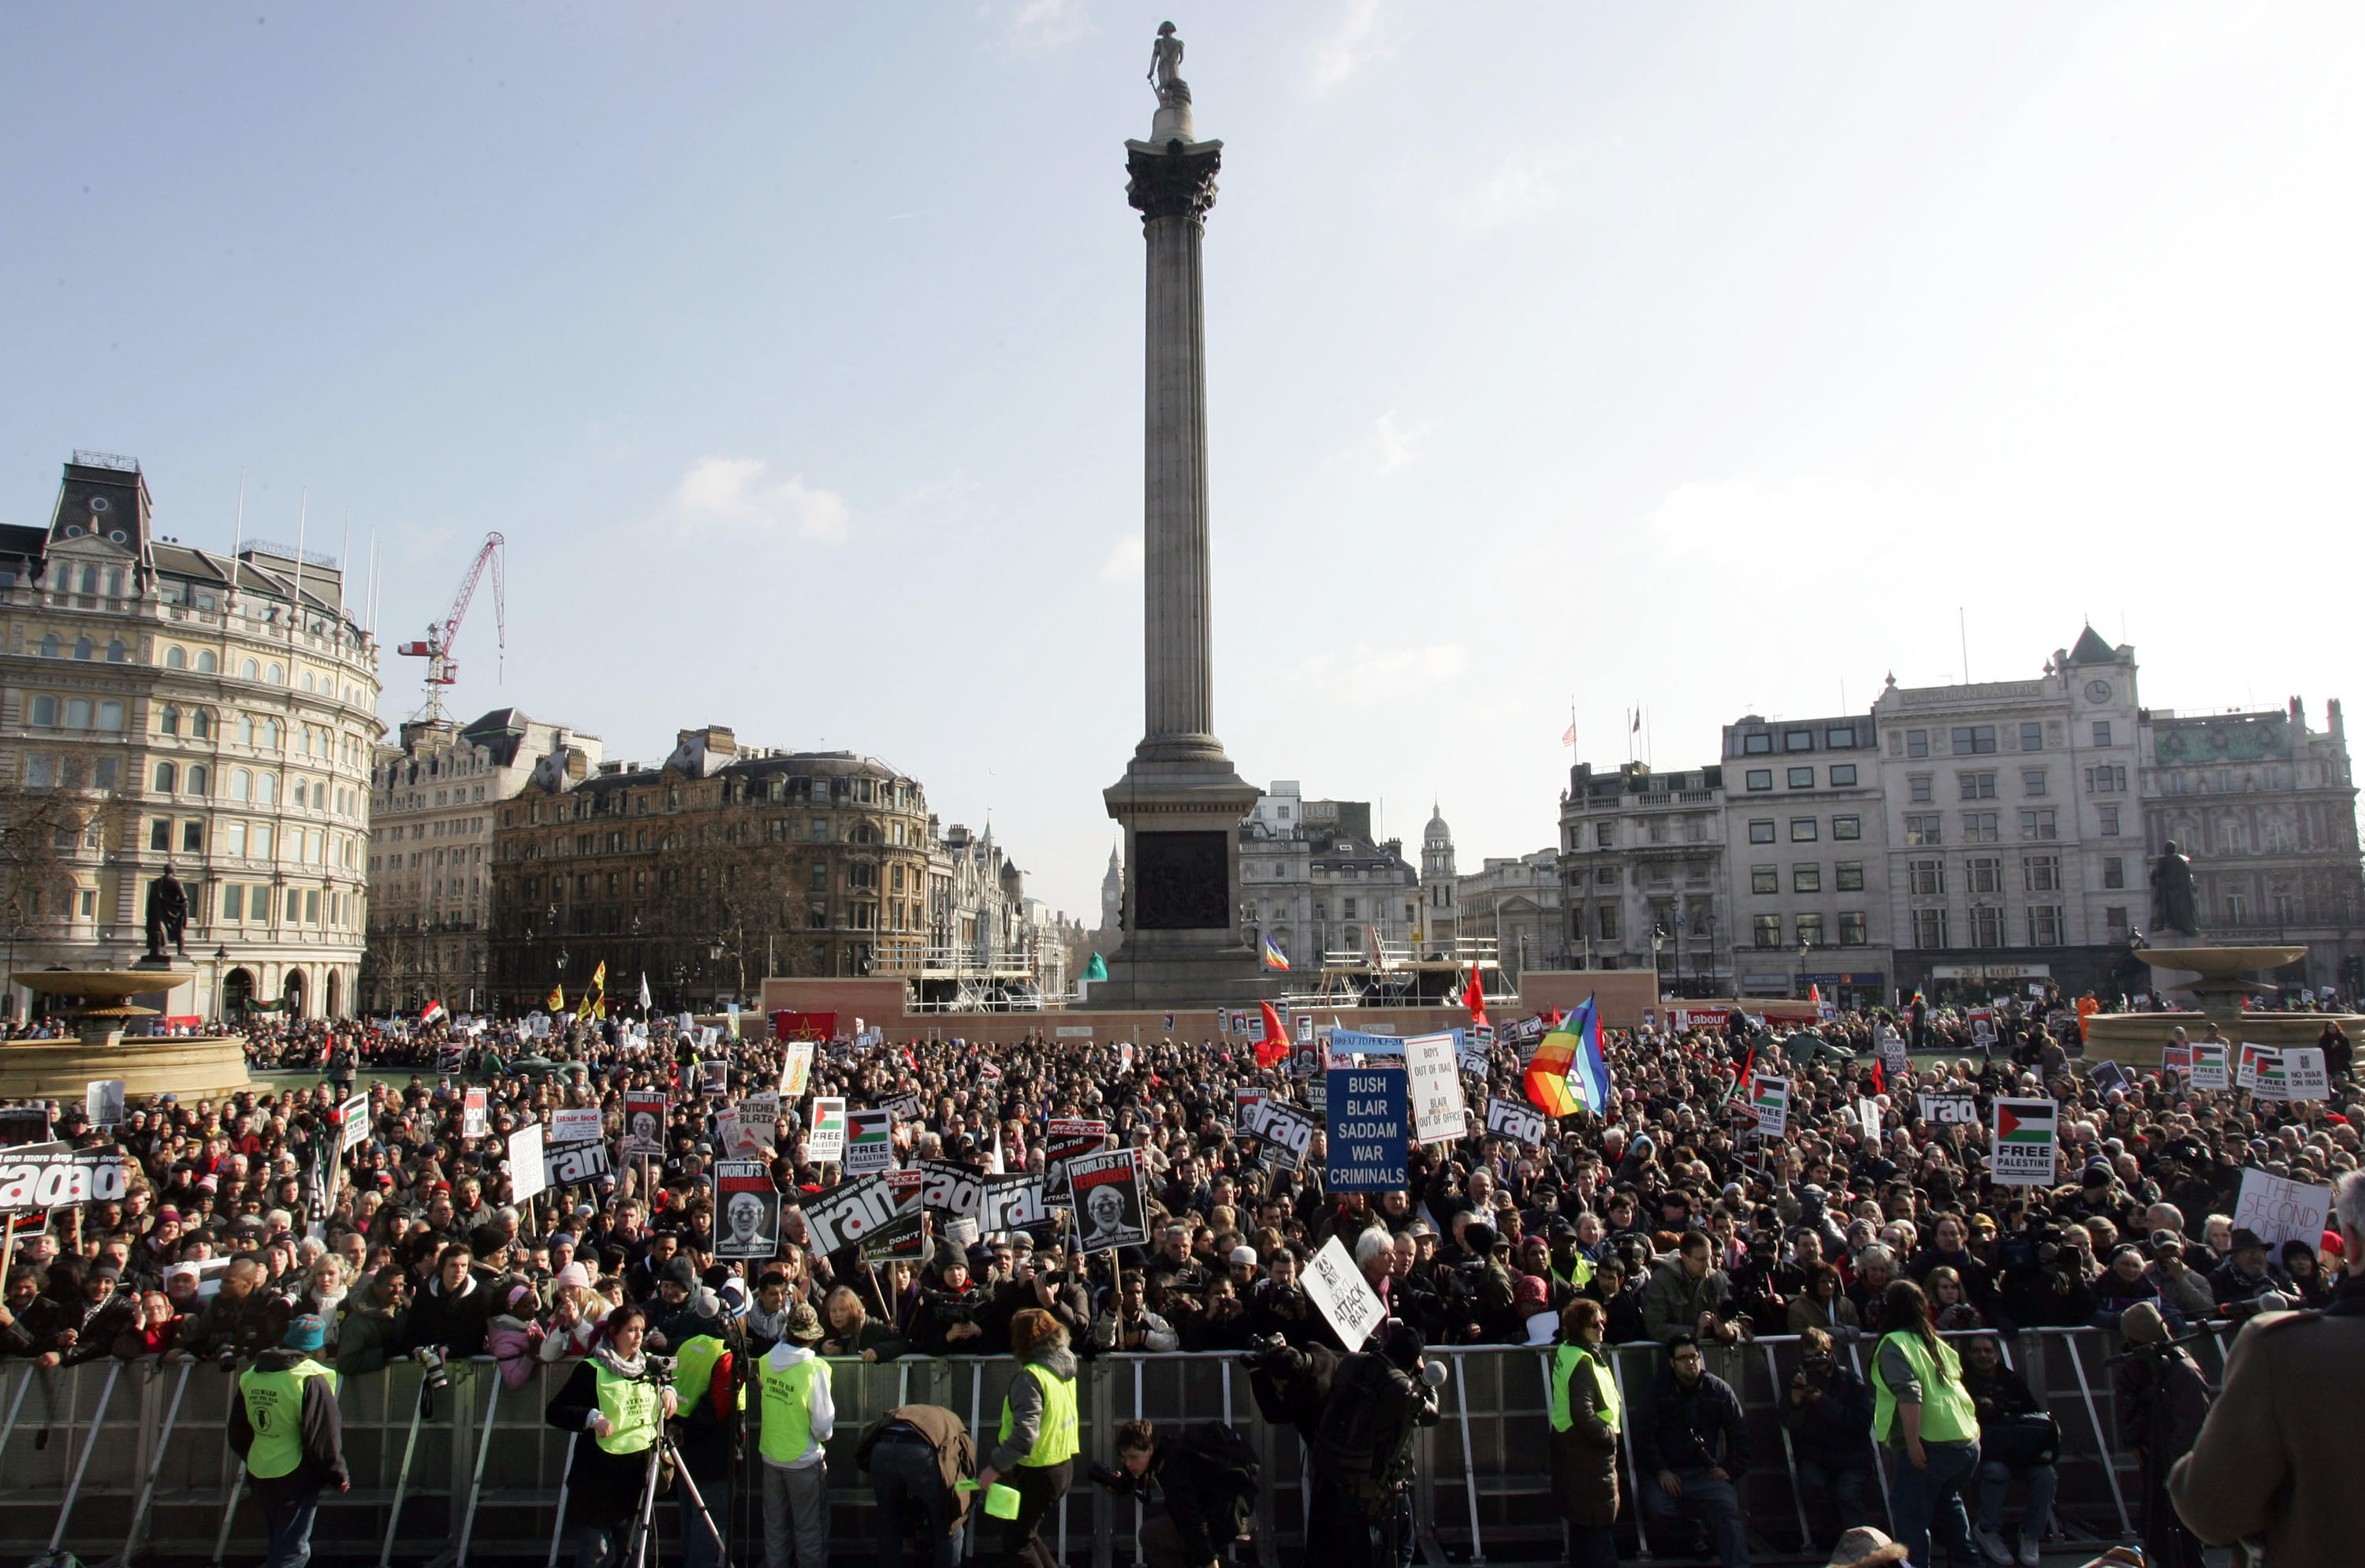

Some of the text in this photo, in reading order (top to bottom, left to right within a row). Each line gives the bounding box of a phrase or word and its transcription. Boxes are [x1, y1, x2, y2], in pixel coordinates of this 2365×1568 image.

[1688, 1014, 1726, 1024] Labour
[1423, 1047, 1439, 1058] BOYS
[1414, 1063, 1451, 1077] OUT OF IRAQ
[1309, 1087, 1326, 1096] STO
[1349, 1077, 1387, 1093] BUSH
[1433, 1081, 1439, 1090] &
[627, 1093, 654, 1103] WORLD'S
[1429, 1097, 1447, 1108] BLAIR
[466, 1108, 483, 1119] GO!
[739, 1103, 776, 1112] BUTCHER
[1347, 1101, 1387, 1116] BLAIR
[1753, 1106, 1782, 1117] REE
[1917, 1093, 1978, 1123] Iraq
[739, 1114, 774, 1123] BLAIR
[1252, 1097, 1312, 1154] Iraq
[1419, 1111, 1461, 1127] OUT OF OFFICE
[1488, 1099, 1542, 1145] Iraq
[1050, 1124, 1104, 1133] RESPECT
[1339, 1123, 1397, 1138] SADDAM
[851, 1144, 888, 1154] FREE
[1048, 1142, 1064, 1153] END
[1066, 1136, 1085, 1147] THE
[1998, 1145, 2050, 1157] FREE
[24, 1153, 49, 1163] more
[51, 1152, 73, 1164] drop
[851, 1153, 888, 1162] PALESTINE
[1352, 1145, 1384, 1161] WAR
[544, 1145, 605, 1186] ran
[1071, 1154, 1130, 1176] WORLD'S #1
[1998, 1157, 2050, 1168] PALESTINE
[719, 1165, 762, 1177] WORLD'S
[946, 1168, 964, 1177] more
[965, 1172, 982, 1184] drop
[1072, 1167, 1132, 1190] TERRORIST
[1331, 1168, 1405, 1184] CRIMINALS
[988, 1183, 1000, 1193] Not
[1001, 1181, 1014, 1190] one
[1015, 1177, 1033, 1186] more
[2265, 1175, 2302, 1203] THE
[806, 1174, 877, 1216] Not one more drop
[1043, 1194, 1071, 1202] ATTACK
[2241, 1193, 2318, 1228] SECOND
[801, 1180, 897, 1259] Iran
[889, 1231, 920, 1246] DON'T
[1086, 1231, 1140, 1248] Socialist Worker
[868, 1245, 893, 1256] TTACK
[1331, 1278, 1351, 1305] DON'T
[1334, 1283, 1366, 1326] ATTACK
[1347, 1302, 1369, 1331] IRAN
